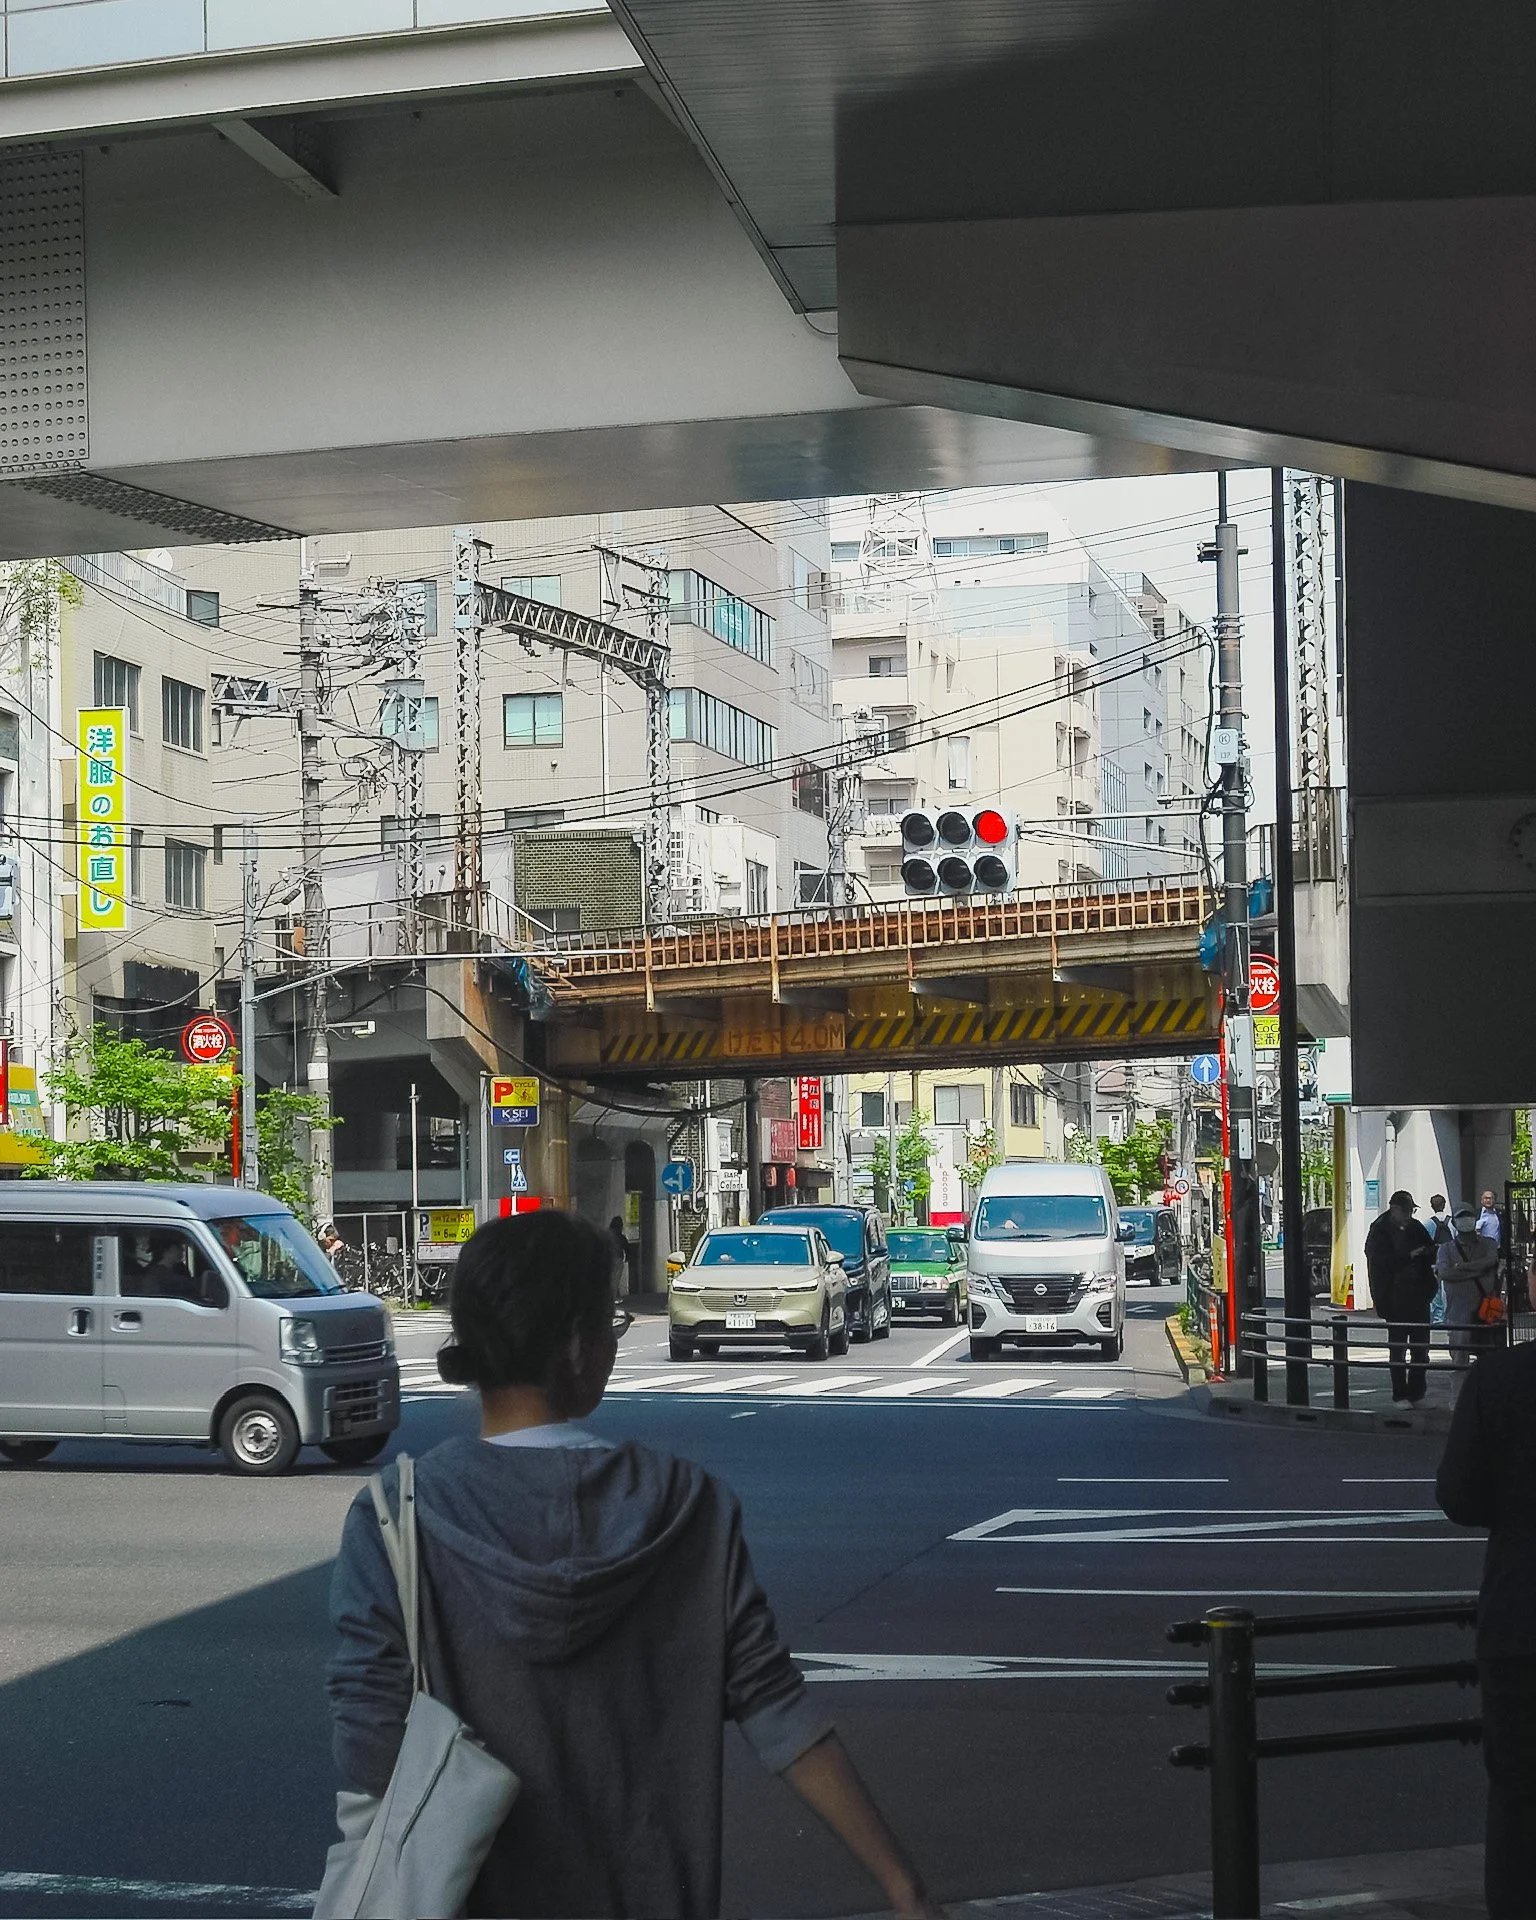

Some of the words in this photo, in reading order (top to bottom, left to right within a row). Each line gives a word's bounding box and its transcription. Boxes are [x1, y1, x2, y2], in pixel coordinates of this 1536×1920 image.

[89, 727, 114, 912] 洋服のお直し
[192, 1034, 223, 1049] 消火栓
[790, 1024, 844, 1051] 4.0M
[494, 1082, 513, 1104] P
